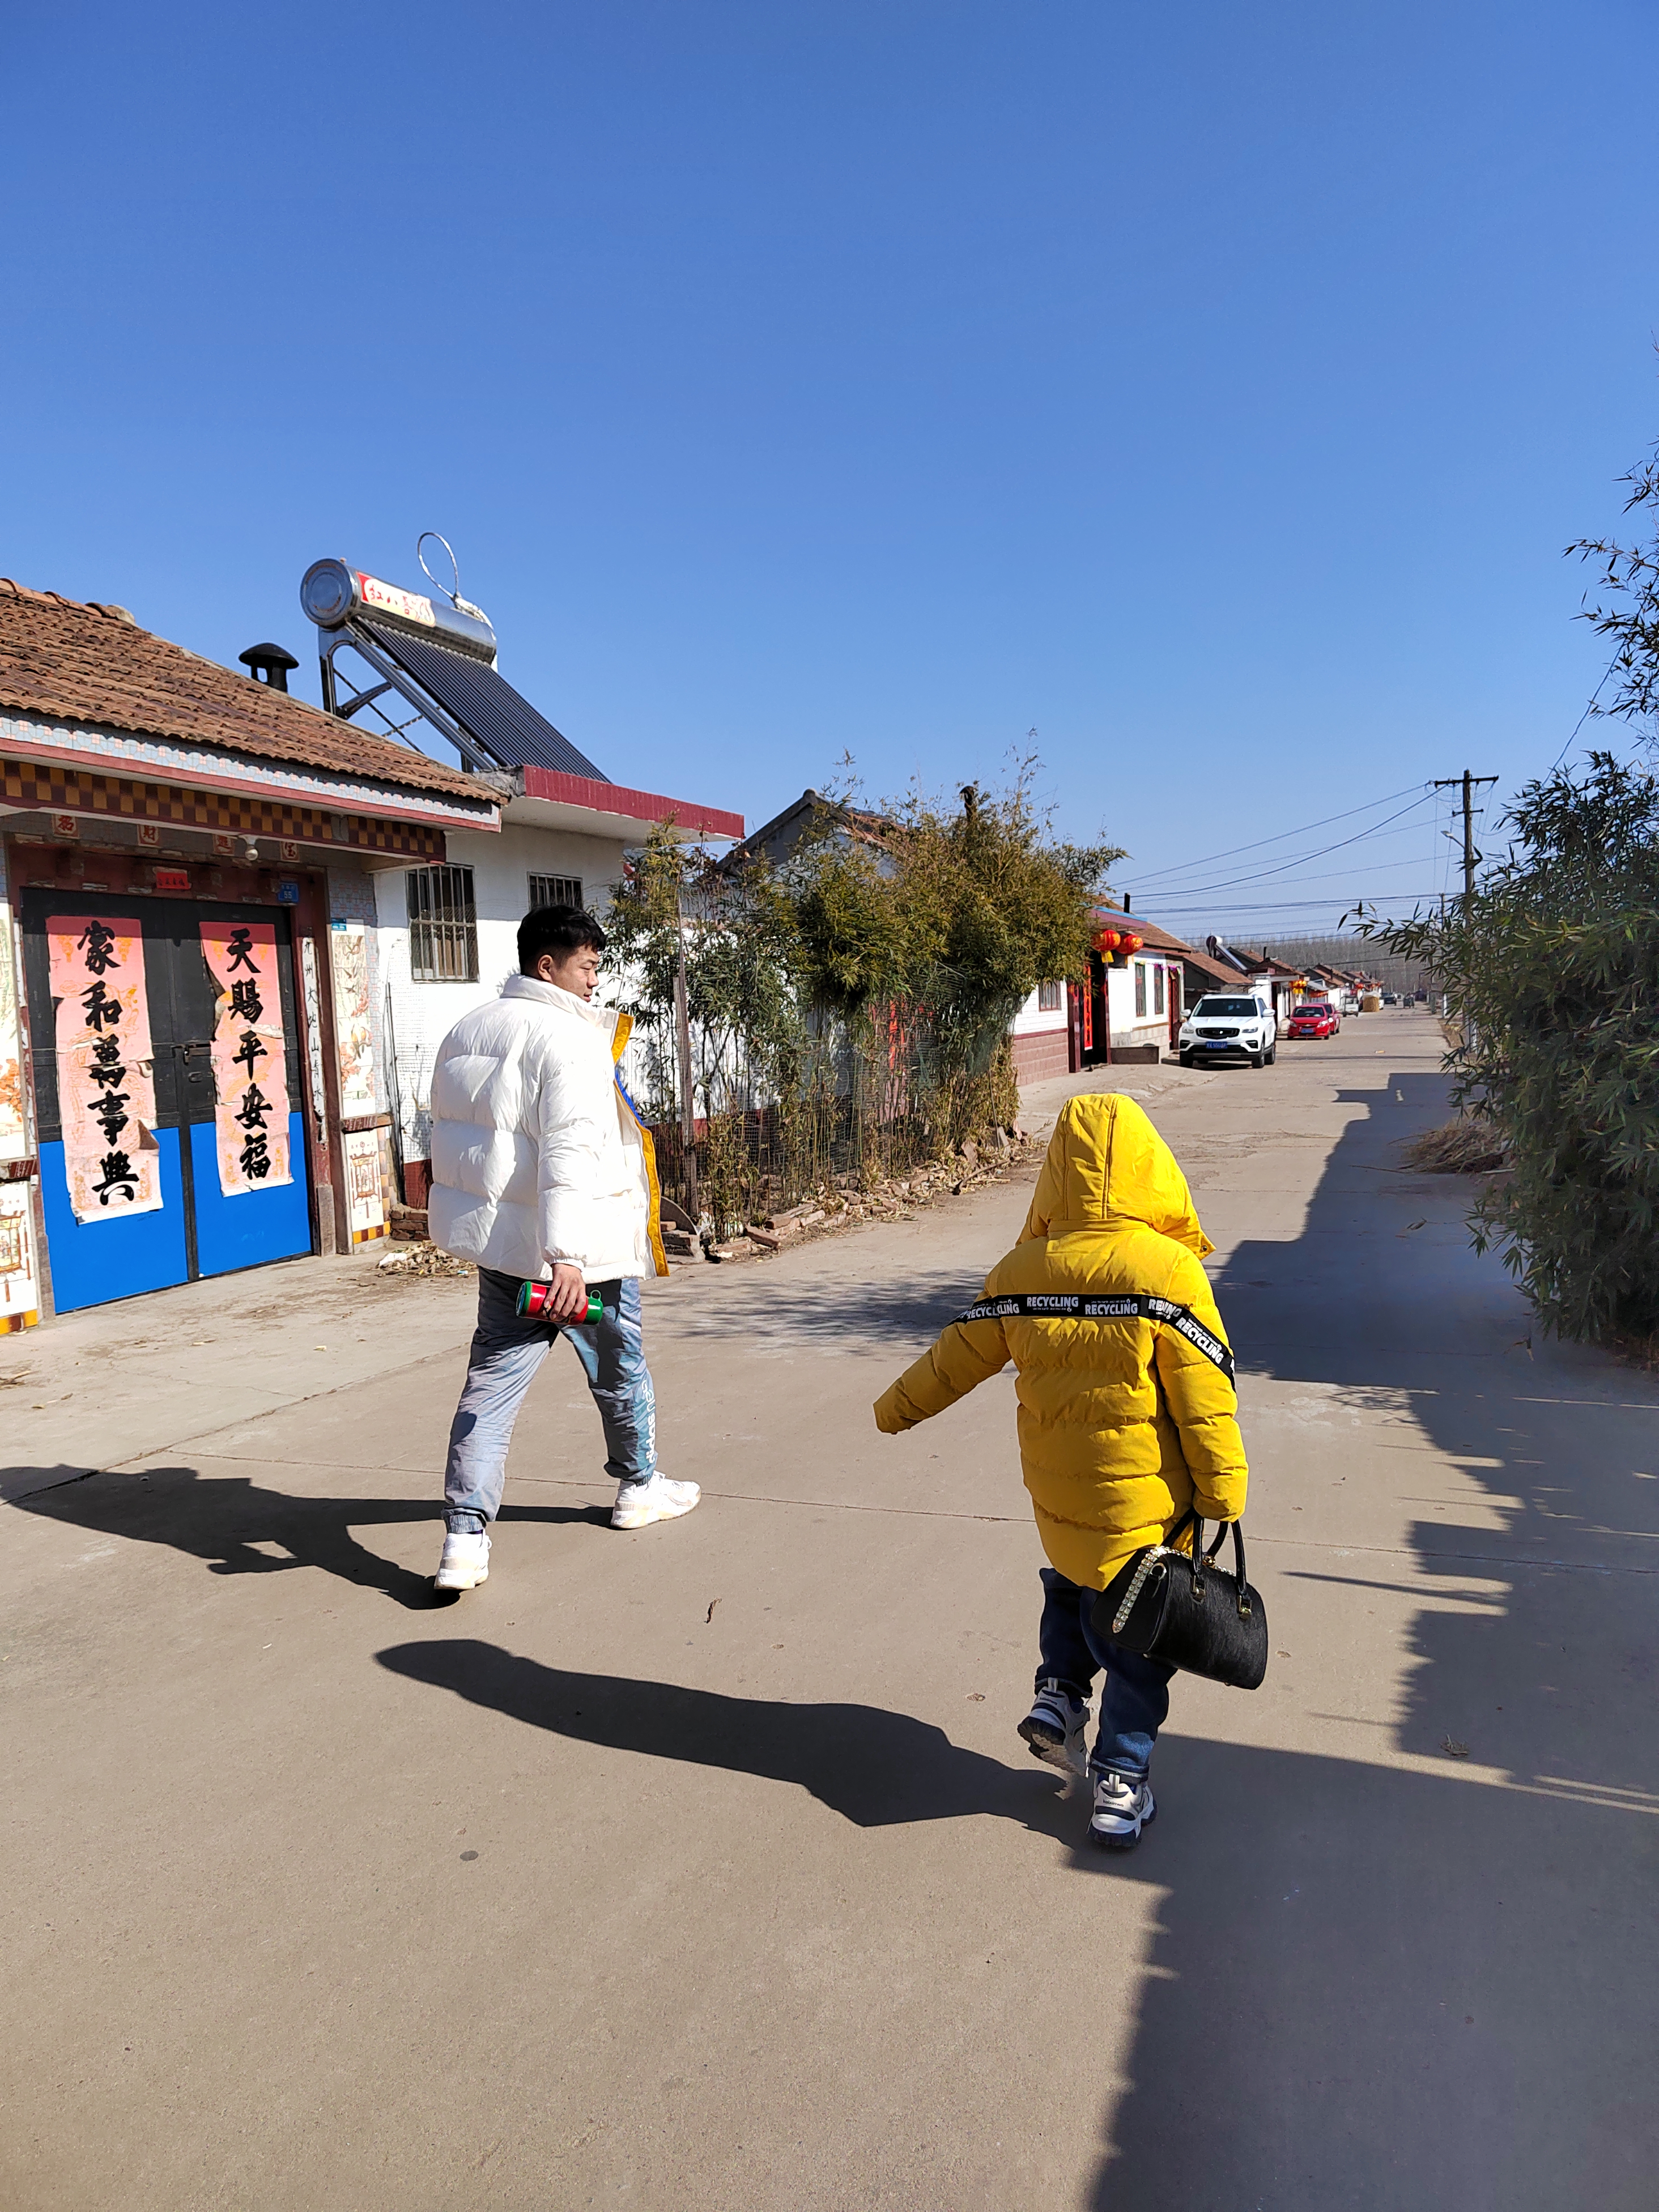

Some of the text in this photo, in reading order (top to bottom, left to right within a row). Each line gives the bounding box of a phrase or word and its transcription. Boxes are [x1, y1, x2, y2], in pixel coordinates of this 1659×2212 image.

[1027, 1296, 1079, 1307] RECYCLING
[1085, 1303, 1138, 1315] RECYCLING
[1176, 1317, 1224, 1364] RECYCLING
